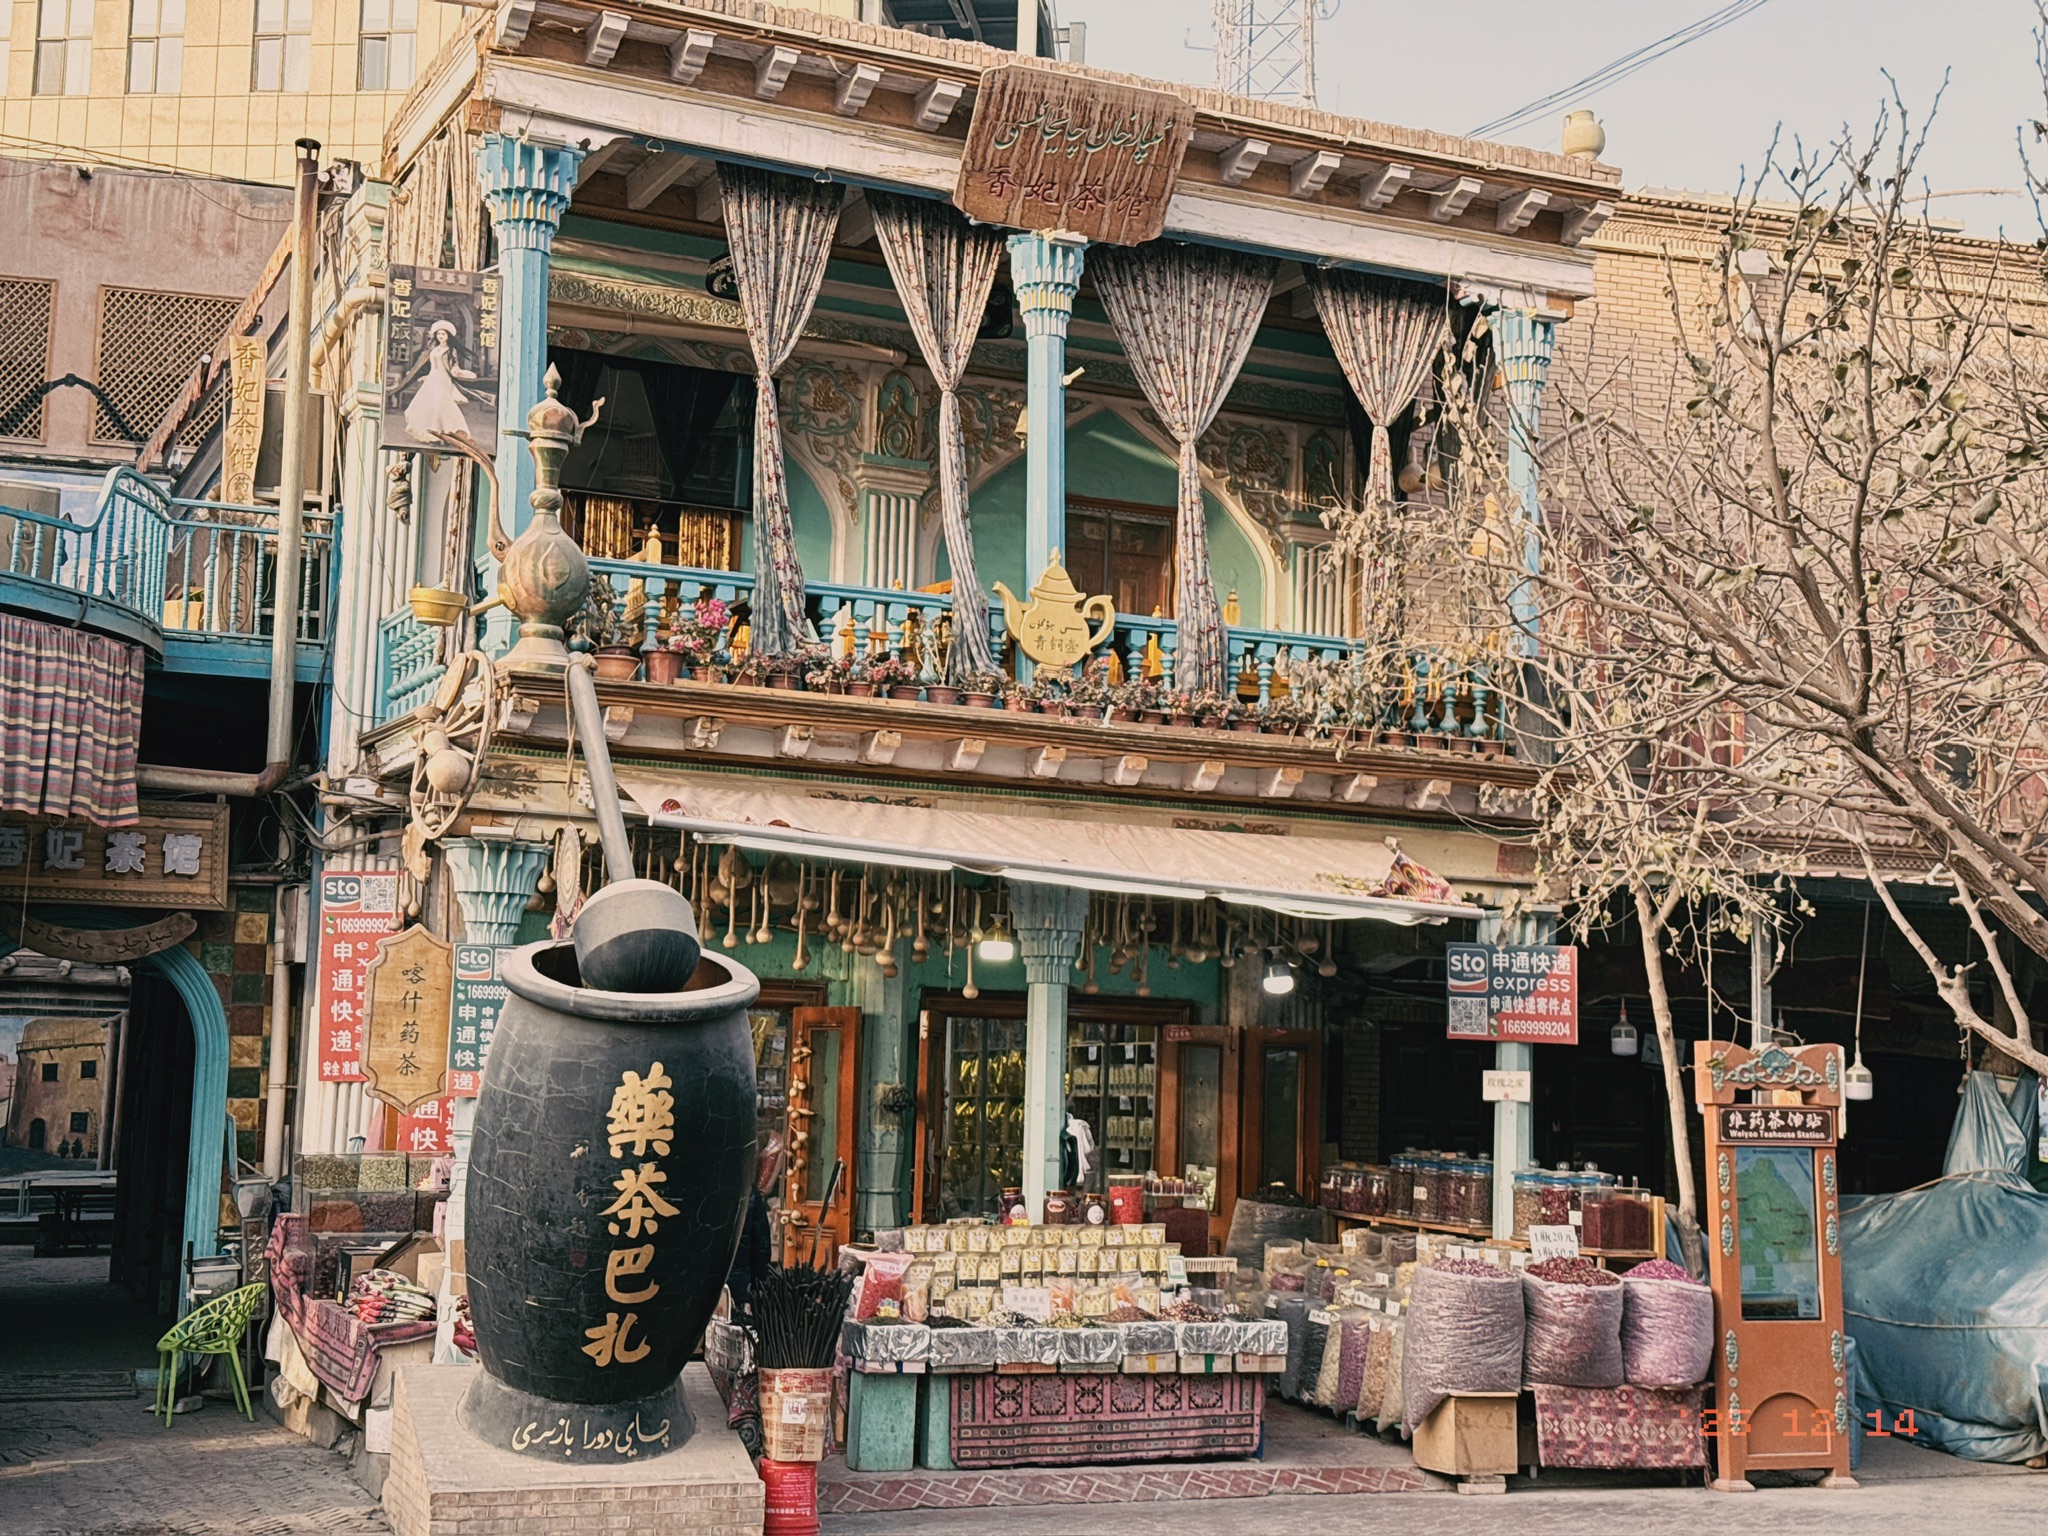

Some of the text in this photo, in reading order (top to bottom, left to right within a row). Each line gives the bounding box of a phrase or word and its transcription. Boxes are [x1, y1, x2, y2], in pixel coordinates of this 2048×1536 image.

[982, 165, 1150, 218] 香妃茶馆
[390, 278, 413, 362] 香妃旅拍
[479, 278, 499, 348] 香妃茶馆
[227, 343, 263, 471] 香妃茶馆
[0, 827, 203, 876] 香妃茶馆
[325, 879, 360, 896] sto
[336, 917, 402, 934] 166999992
[459, 950, 490, 965] sto
[1449, 952, 1486, 973] sto
[1492, 951, 1572, 975] 申通快递
[1492, 975, 1571, 993] express
[331, 940, 354, 1053] 申通快递
[1490, 995, 1572, 1016] 申通快递寄件点
[396, 962, 426, 1076] 喀什药茶
[1502, 1020, 1571, 1037] 16699999204
[453, 1003, 477, 1091] 申通快递
[1759, 1130, 1796, 1139] Teahouse
[1797, 1131, 1826, 1139] Station
